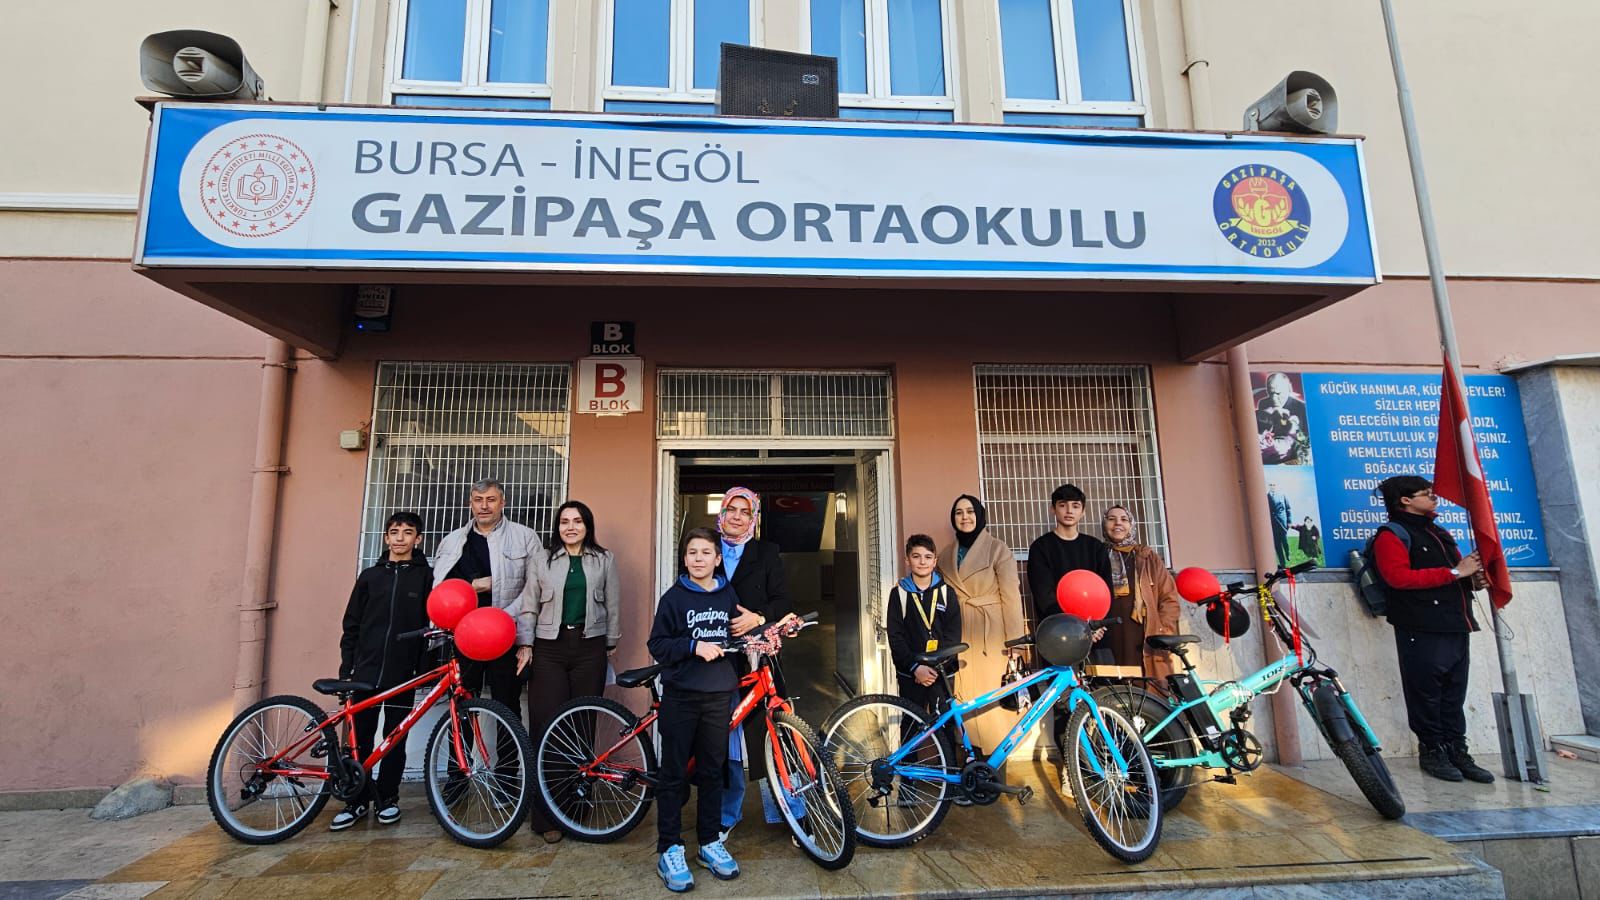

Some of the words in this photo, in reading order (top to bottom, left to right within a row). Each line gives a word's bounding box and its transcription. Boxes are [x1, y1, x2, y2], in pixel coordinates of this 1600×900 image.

[354, 140, 525, 178] BURSA
[574, 138, 760, 184] İNEGÖL
[351, 185, 717, 251] GAZİPAŞA
[736, 201, 1147, 250] ORTAOKULU
[1219, 221, 1310, 257] ORTAOKULU
[1257, 238, 1276, 247] 2012
[603, 323, 623, 342] B
[592, 344, 631, 354] BLOK
[595, 363, 626, 398] B
[1320, 381, 1359, 396] KÜÇÜK
[1361, 384, 1421, 397] HANIMLAR,
[589, 400, 630, 411] BLOK
[1375, 398, 1413, 411] SİZLER
[1339, 413, 1400, 427] GELECEĞİN
[1402, 414, 1421, 427] BİR
[1330, 428, 1365, 441] BİRER
[1367, 431, 1426, 442] MUTLULUK
[1348, 445, 1412, 459] MEMLEKETİ
[1364, 461, 1417, 474] BOĞACAK
